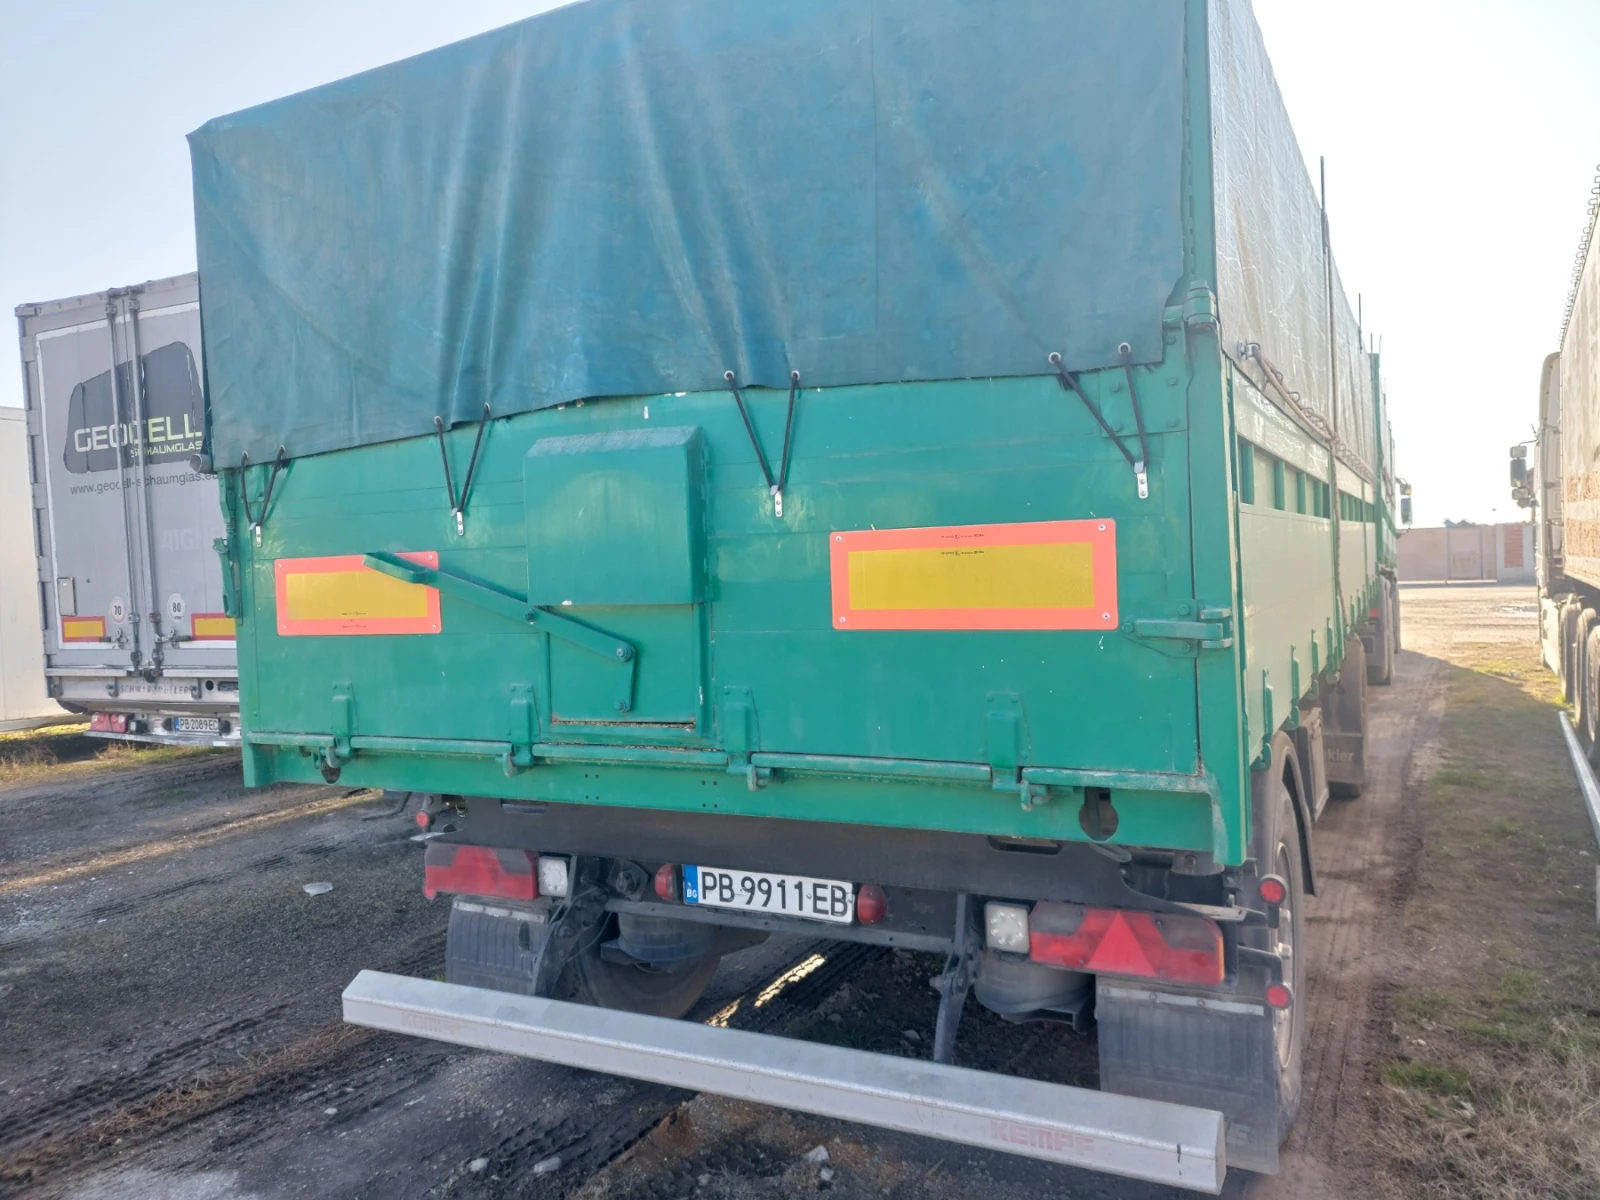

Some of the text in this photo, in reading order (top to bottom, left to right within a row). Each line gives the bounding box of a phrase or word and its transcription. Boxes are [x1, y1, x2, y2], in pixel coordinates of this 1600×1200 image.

[113, 604, 122, 616] 70
[172, 602, 182, 613] 80
[686, 888, 698, 899] BG
[701, 871, 848, 918] PB 9911 EB
